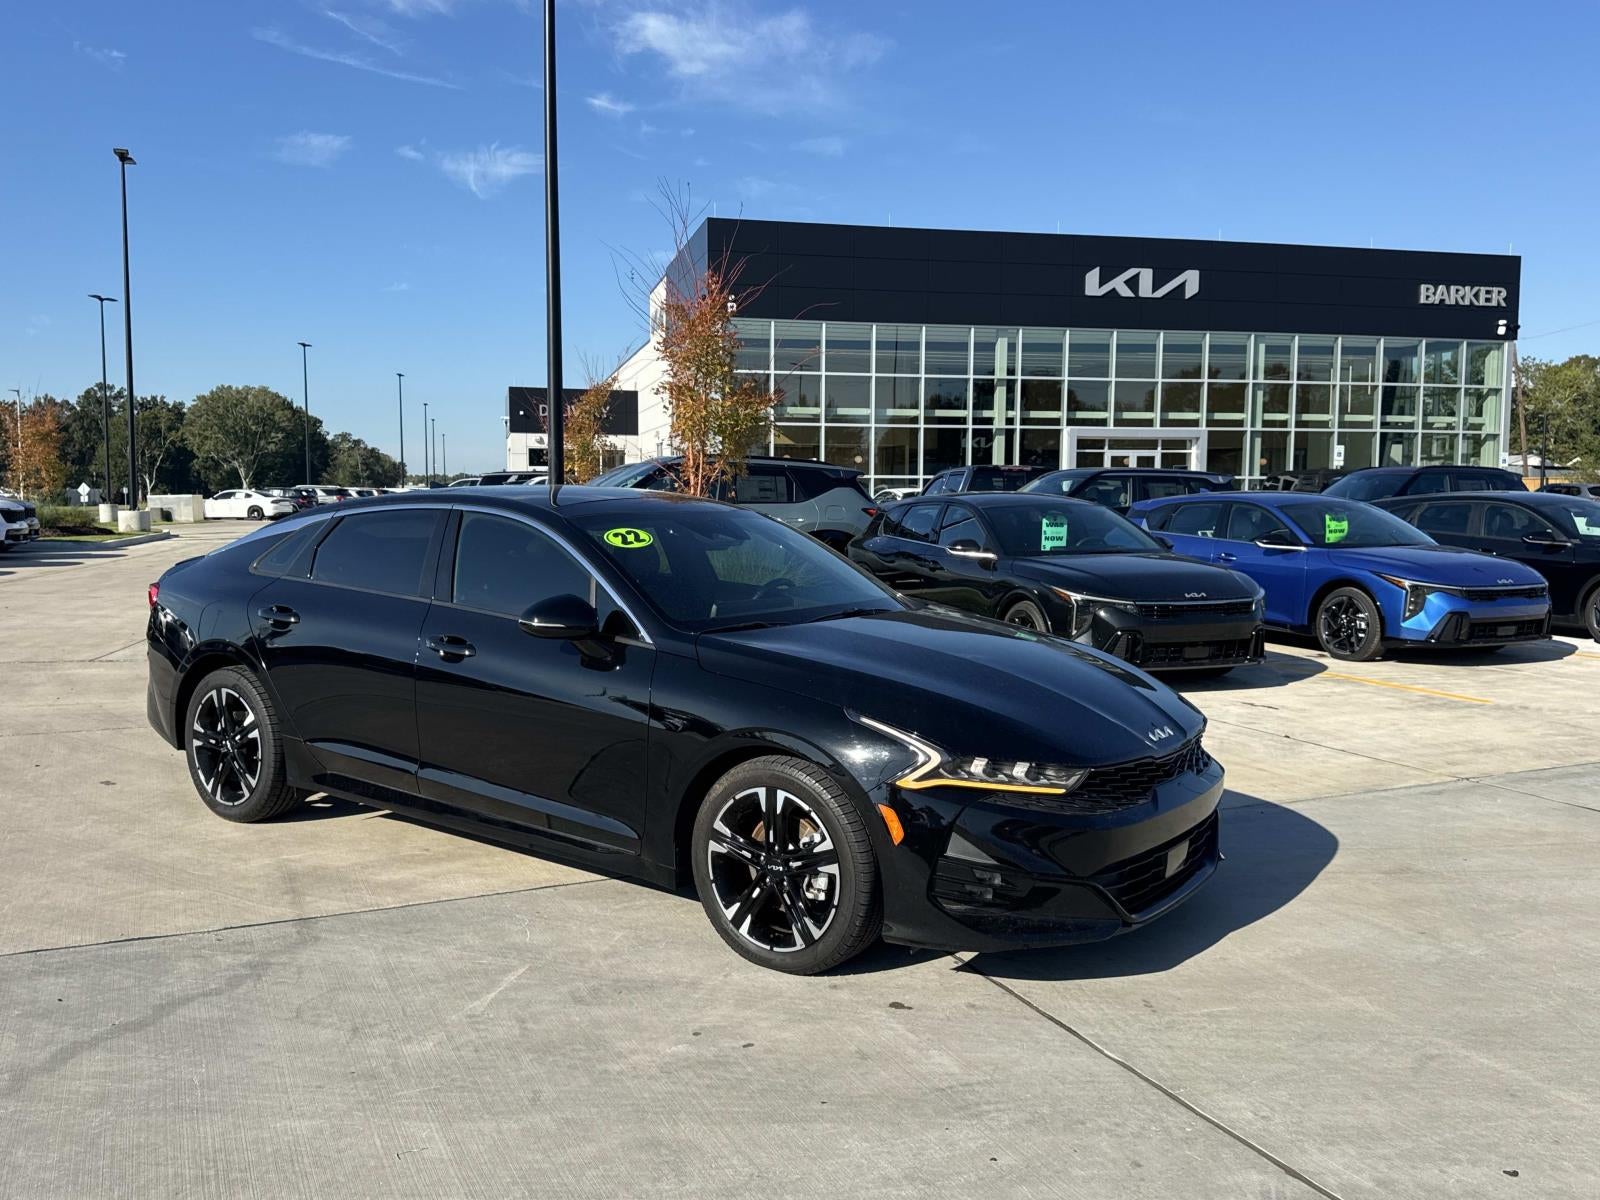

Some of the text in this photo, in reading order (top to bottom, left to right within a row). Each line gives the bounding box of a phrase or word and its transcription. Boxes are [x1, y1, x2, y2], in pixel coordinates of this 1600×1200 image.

[1085, 266, 1200, 300] KIA
[1419, 283, 1507, 307] BARKER
[612, 530, 647, 545] 22
